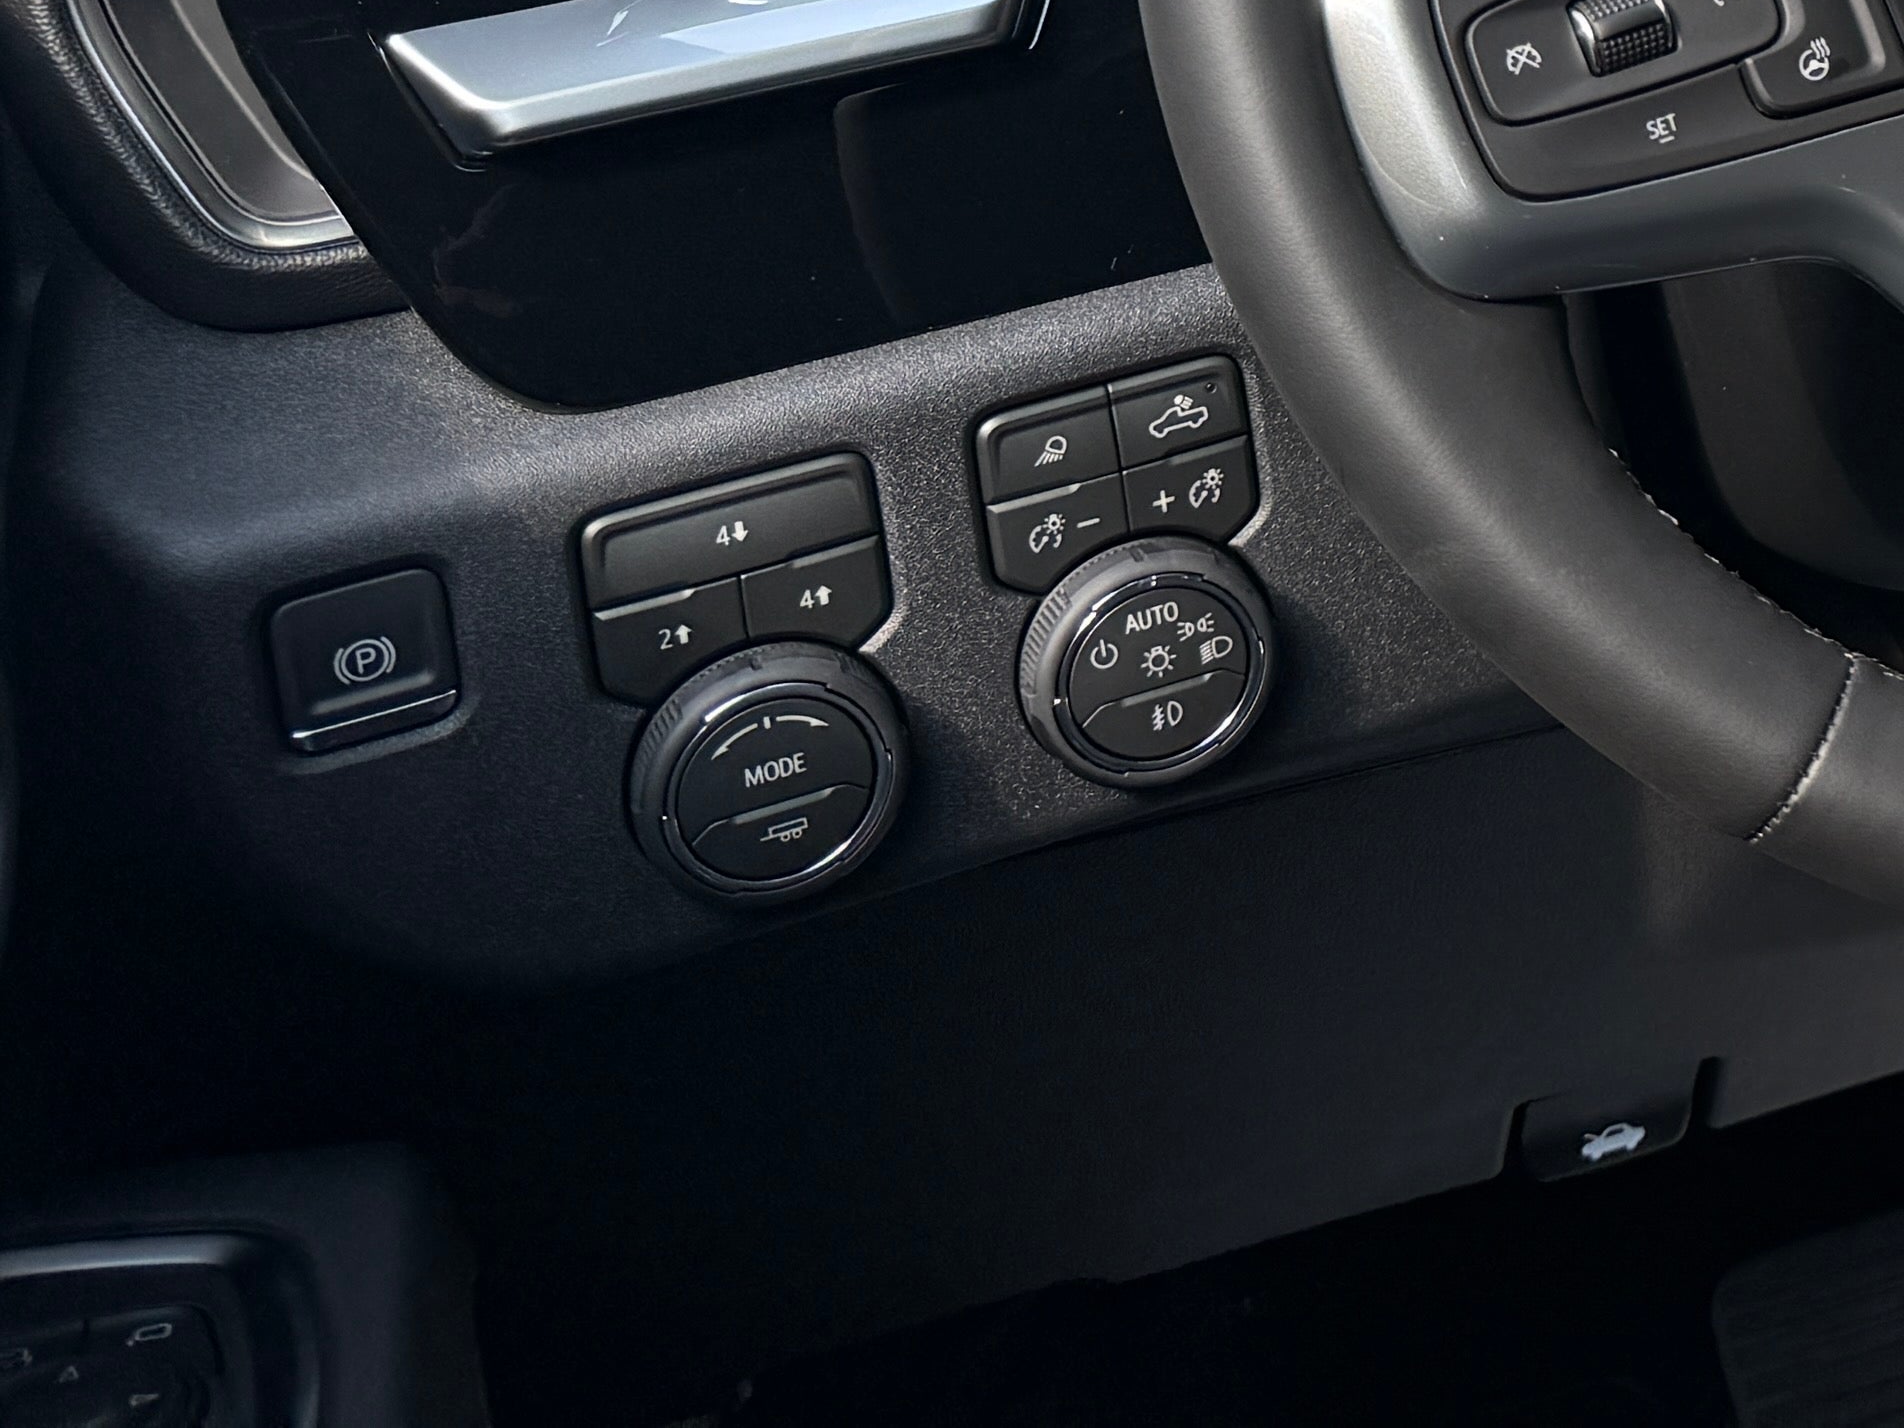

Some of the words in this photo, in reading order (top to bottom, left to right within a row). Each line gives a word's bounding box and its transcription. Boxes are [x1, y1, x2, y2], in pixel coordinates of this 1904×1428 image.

[1646, 112, 1678, 137] SET
[715, 525, 731, 546] 4
[800, 589, 815, 609] 4
[1125, 601, 1179, 635] AUTO
[658, 628, 674, 650] 2
[744, 752, 807, 788] MODE
